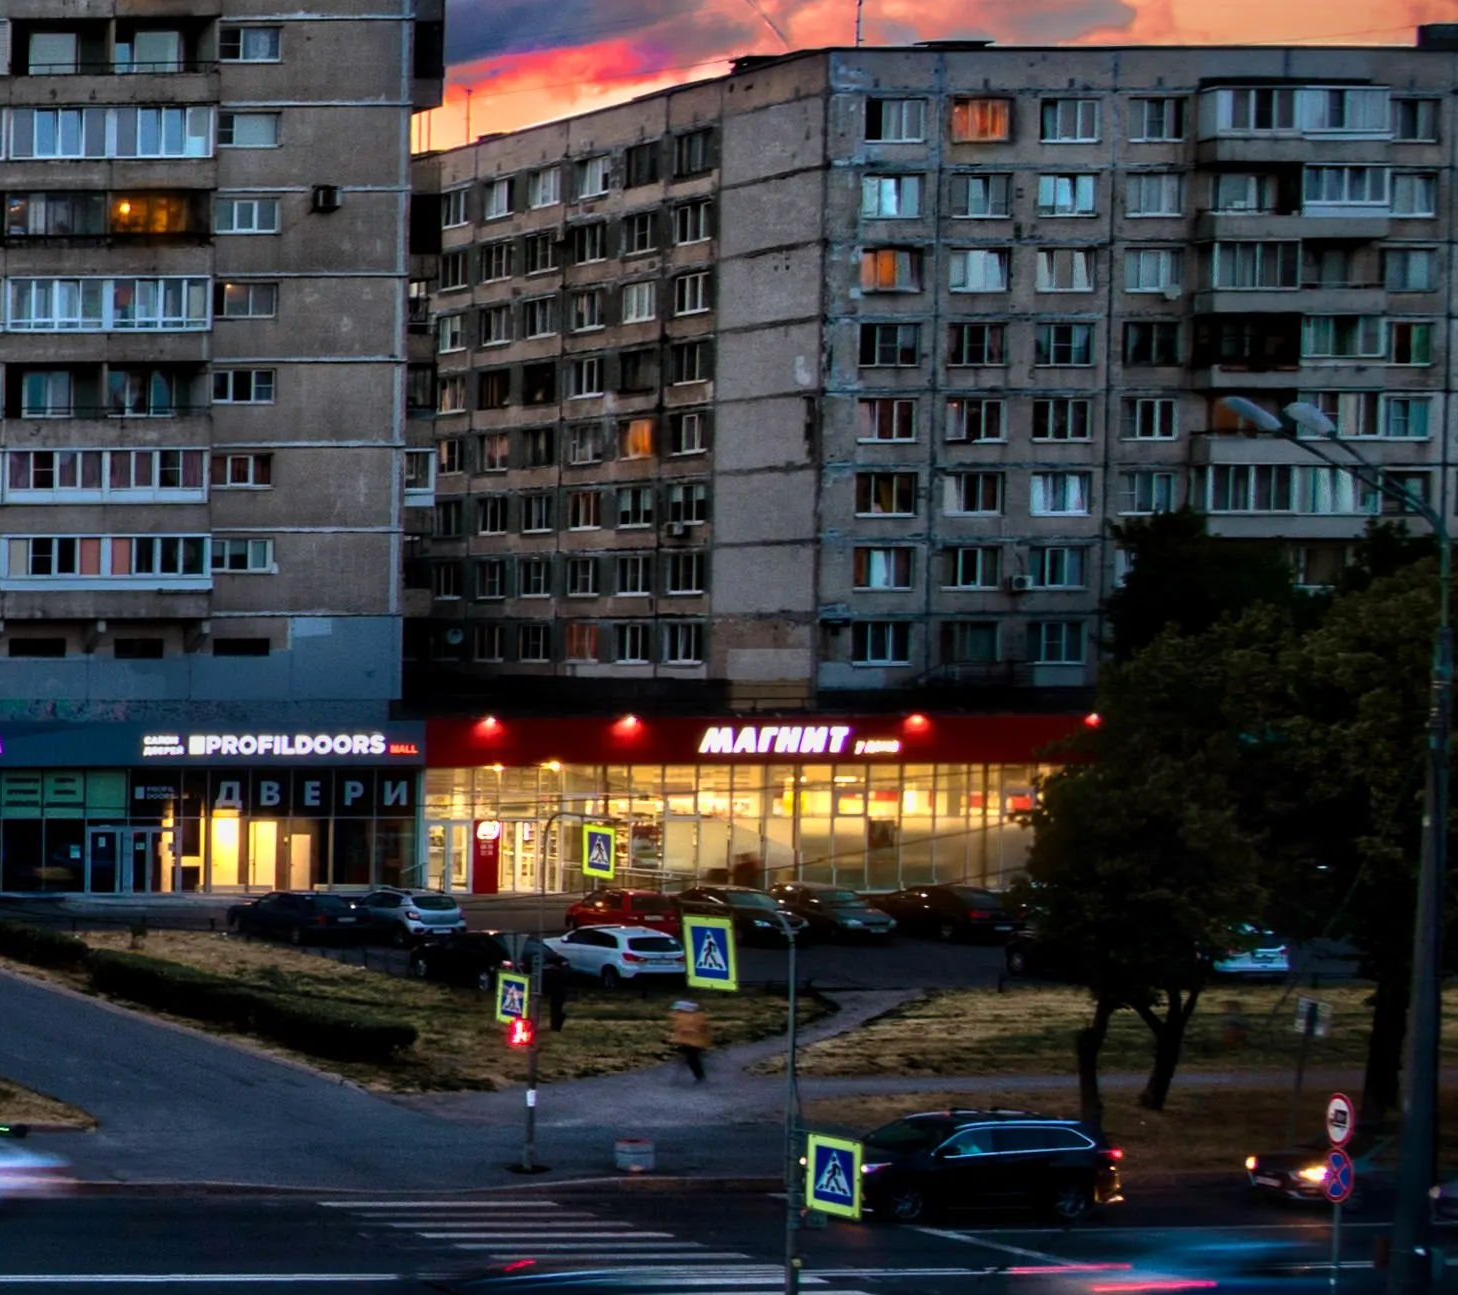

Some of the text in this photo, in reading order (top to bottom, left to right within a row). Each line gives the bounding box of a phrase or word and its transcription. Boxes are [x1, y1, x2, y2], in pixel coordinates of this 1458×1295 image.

[205, 735, 419, 755] PROFILDOORS MALL
[698, 726, 850, 753] МАГНИТ
[215, 781, 408, 808] ДВЕРИ
